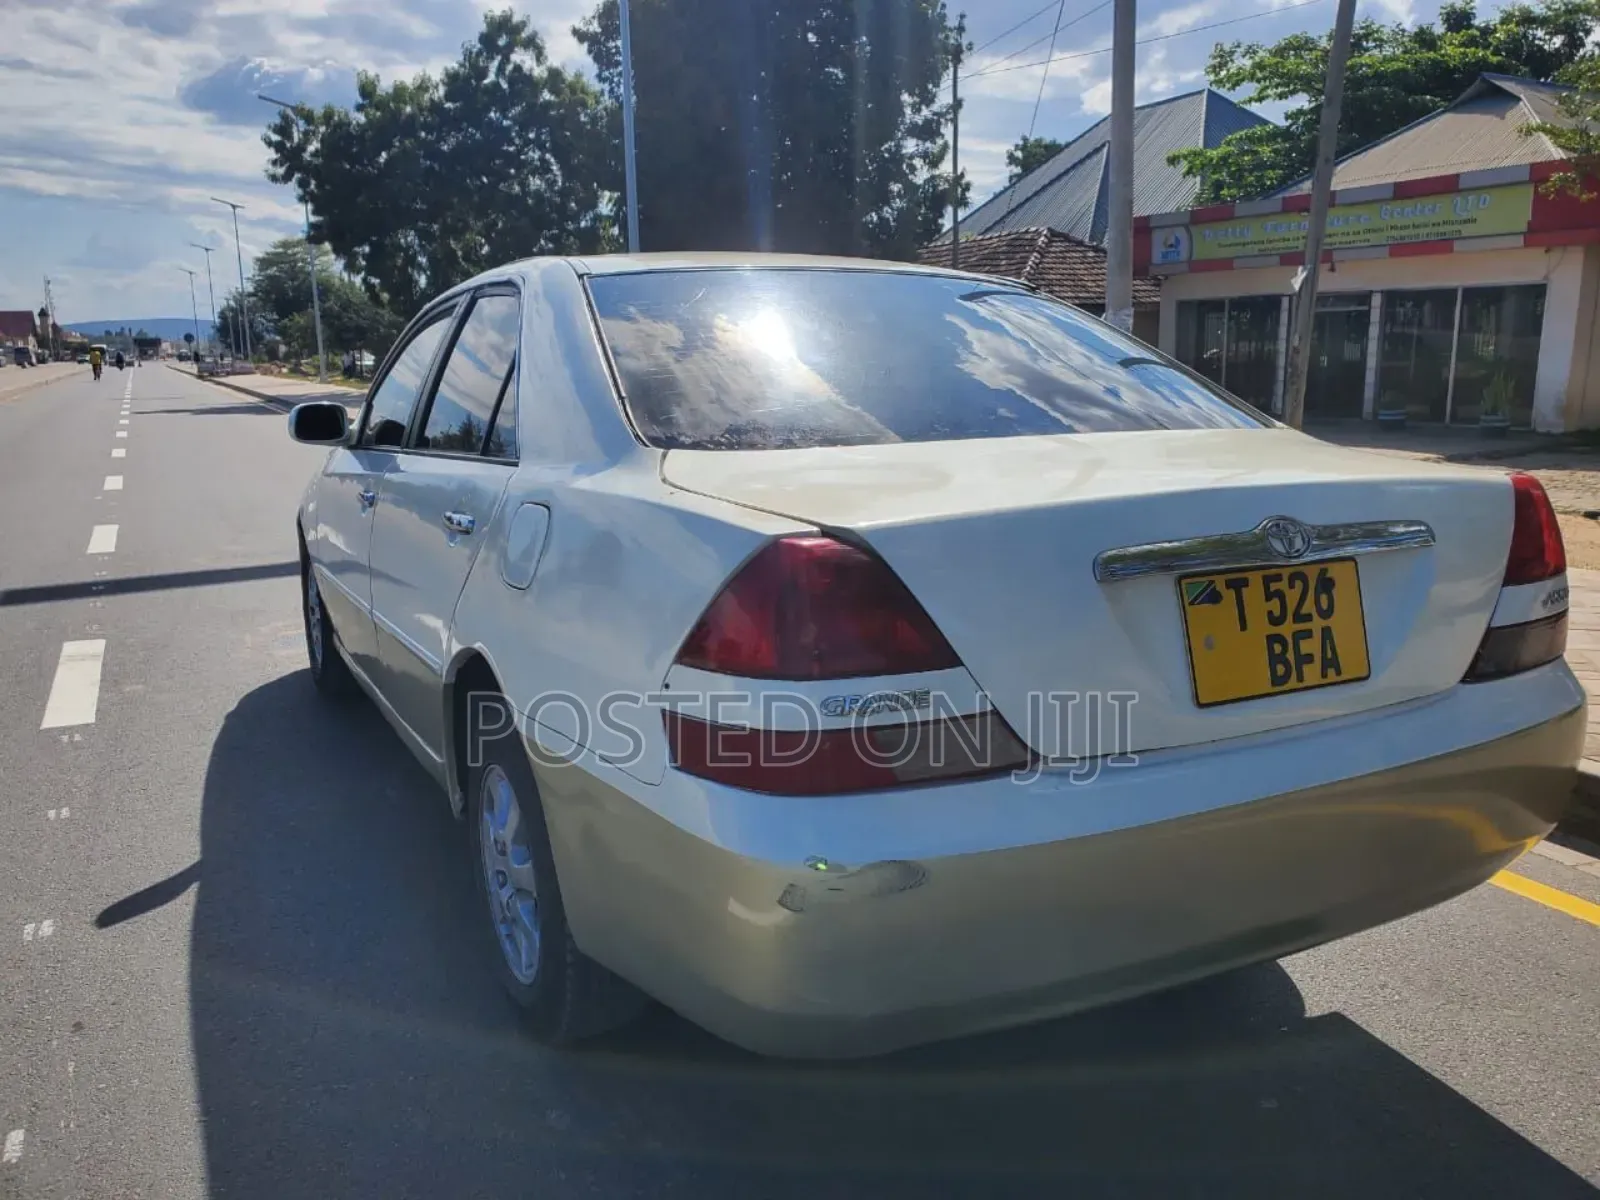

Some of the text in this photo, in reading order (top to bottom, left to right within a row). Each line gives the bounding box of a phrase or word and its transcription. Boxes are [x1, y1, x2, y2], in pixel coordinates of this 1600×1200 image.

[1453, 194, 1491, 217] LTD
[1224, 567, 1336, 632] T 526
[1265, 625, 1342, 687] BFA
[819, 687, 931, 717] GRANDE
